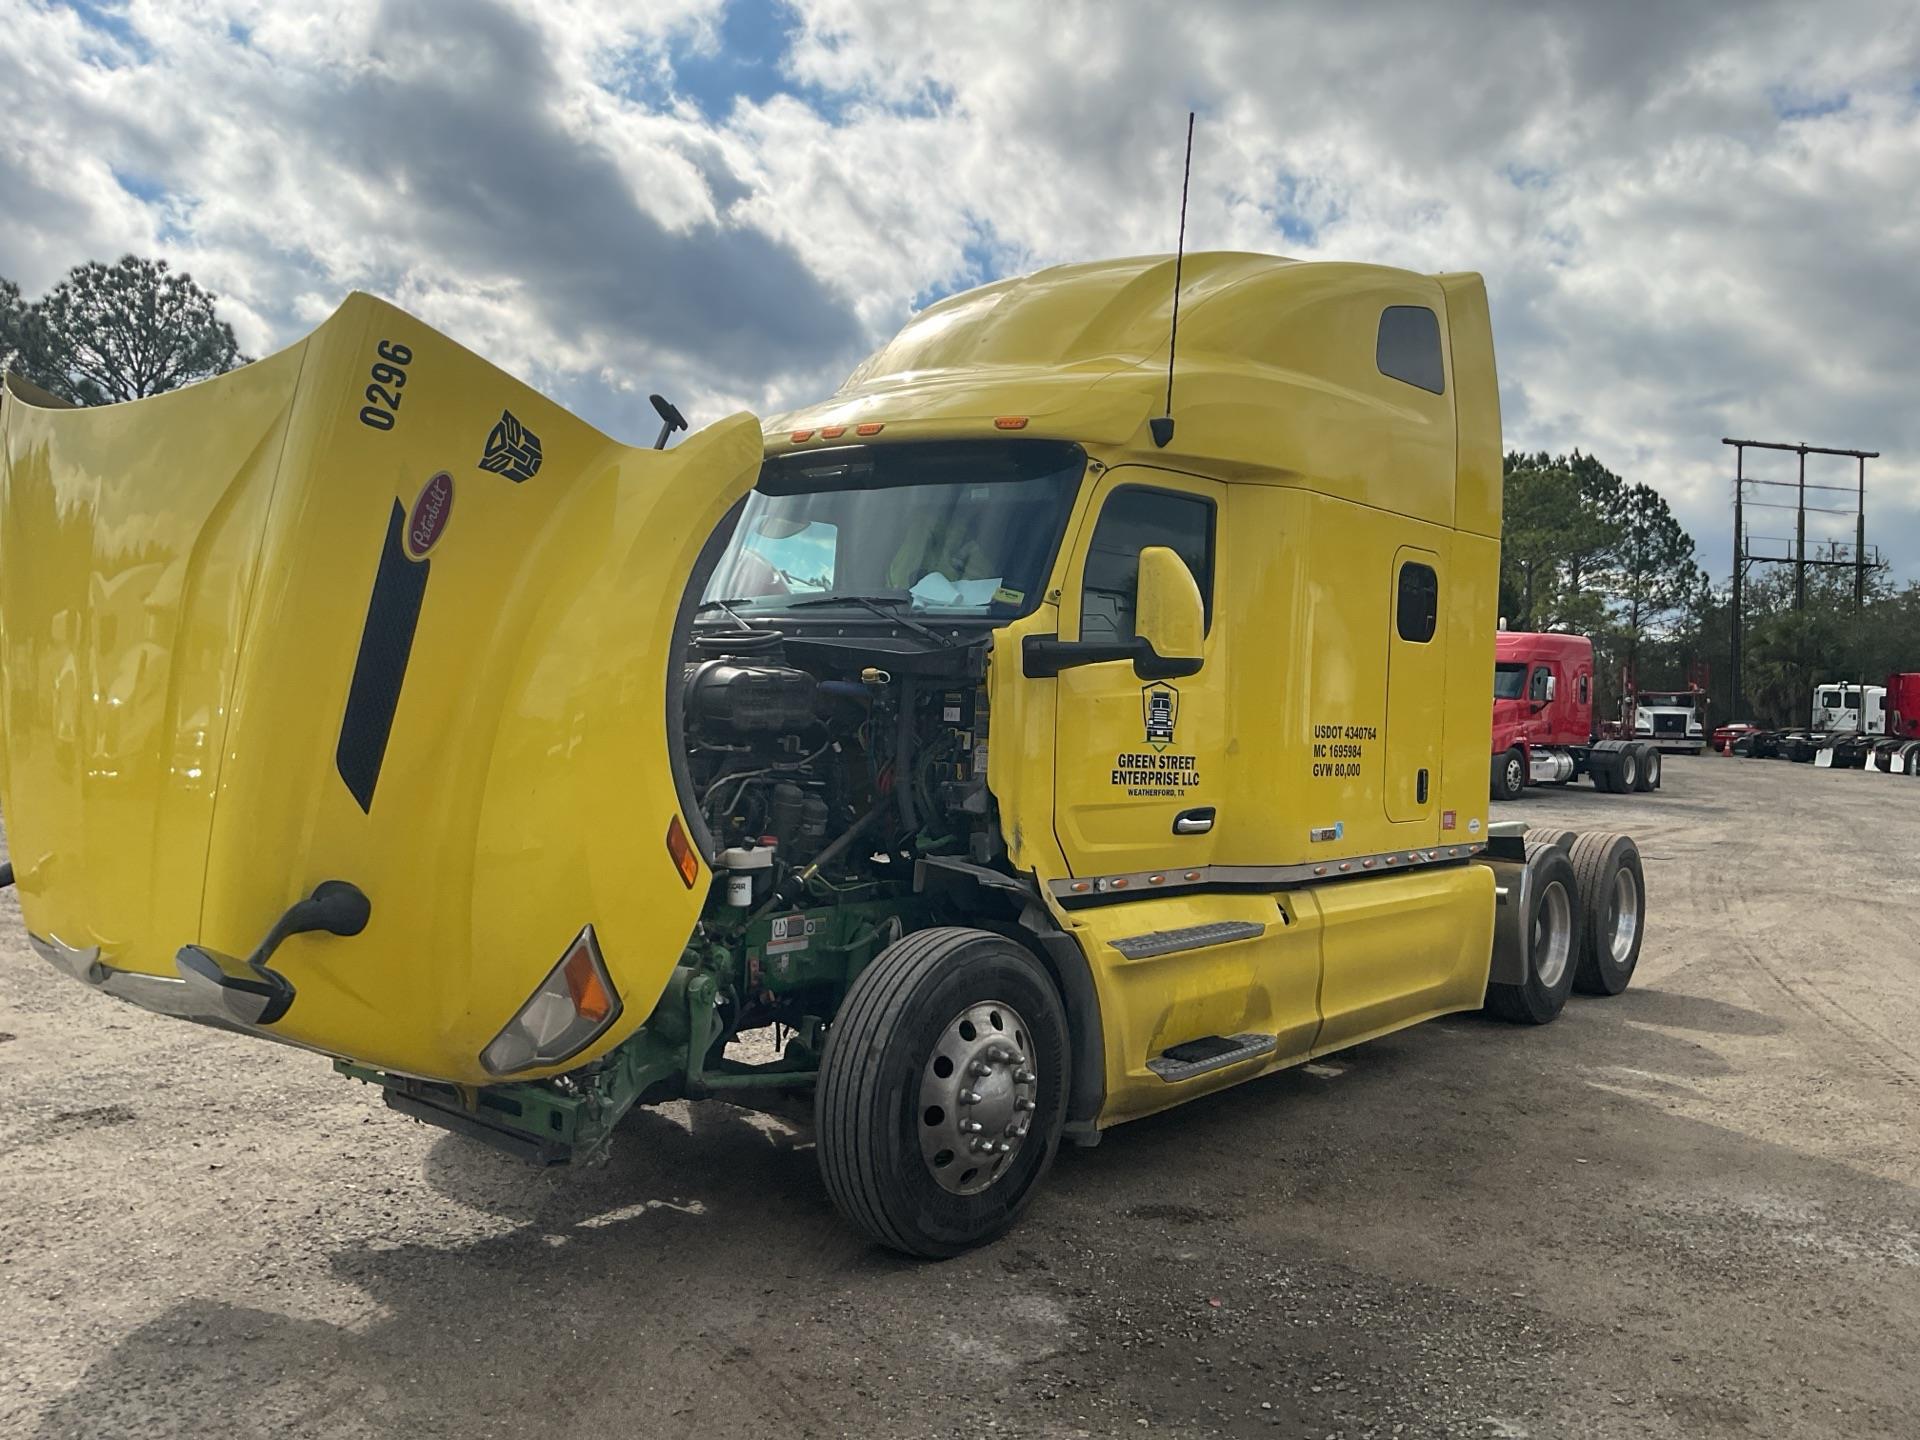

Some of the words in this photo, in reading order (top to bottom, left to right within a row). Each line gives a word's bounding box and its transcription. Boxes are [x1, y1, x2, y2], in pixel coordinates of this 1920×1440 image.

[359, 340, 413, 431] 0296
[412, 479, 448, 548] Peterbilt
[1314, 724, 1343, 739] USDOT
[1344, 726, 1377, 740] 4340764
[1313, 744, 1327, 758] MC
[1329, 744, 1362, 758] 1695984
[1118, 753, 1156, 769] GREEN
[1158, 755, 1196, 770] STREET
[1111, 770, 1179, 786] ENTERPRISE
[1182, 772, 1200, 786] LLC
[1312, 763, 1333, 777] GVW
[1334, 763, 1361, 779] 80,000
[1127, 788, 1176, 797] WEATHERFORD,
[1177, 789, 1185, 797] TX
